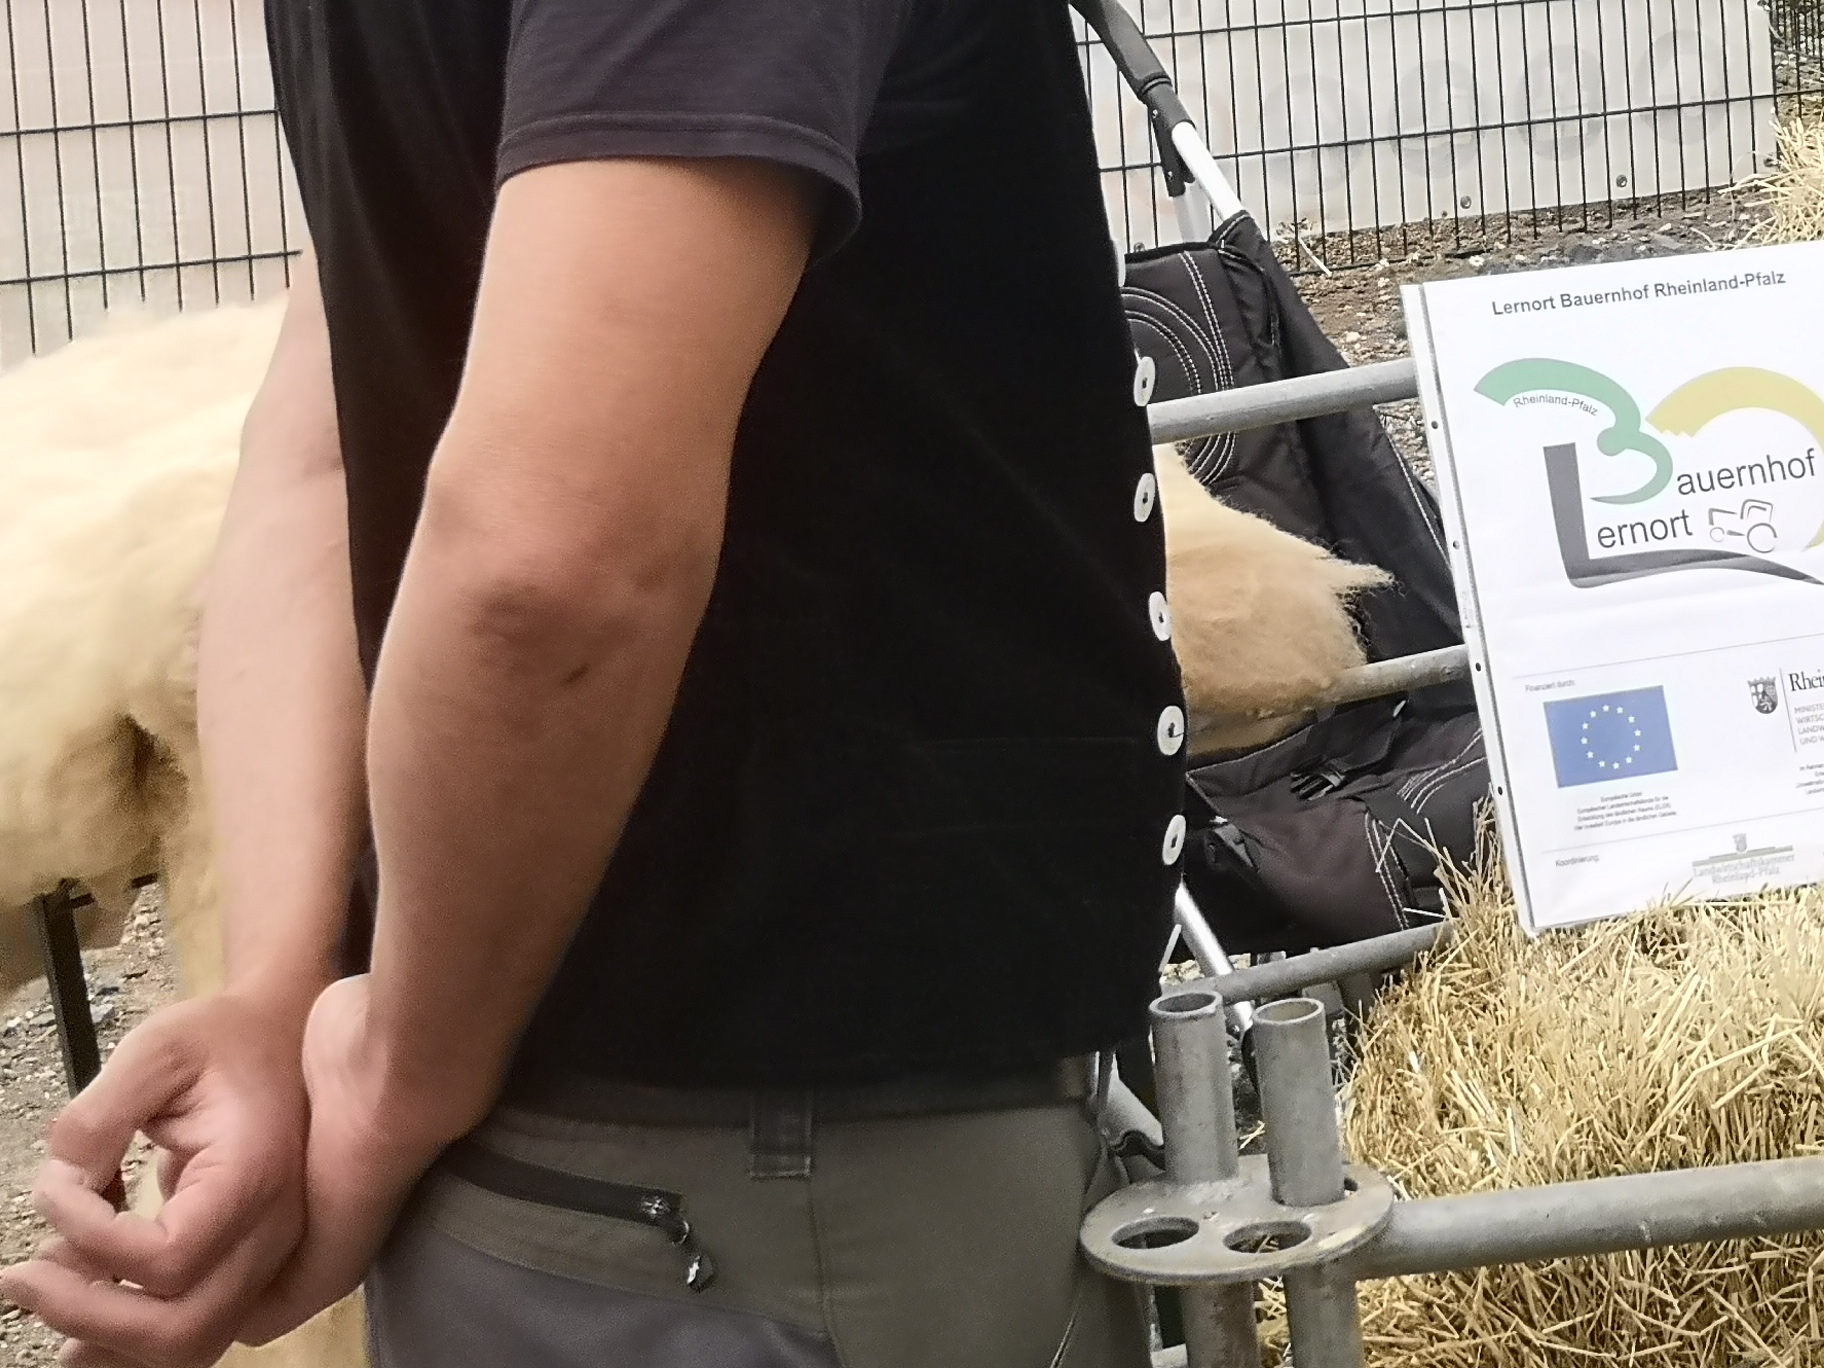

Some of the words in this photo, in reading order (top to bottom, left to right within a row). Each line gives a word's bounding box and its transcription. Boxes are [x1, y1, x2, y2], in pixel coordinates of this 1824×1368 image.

[1492, 298, 1556, 316] Lernort
[1560, 284, 1650, 309] Bauernhof
[1654, 271, 1786, 298] Rheinland-Pfalz
[1513, 393, 1599, 417] Rheinland-Pfalz
